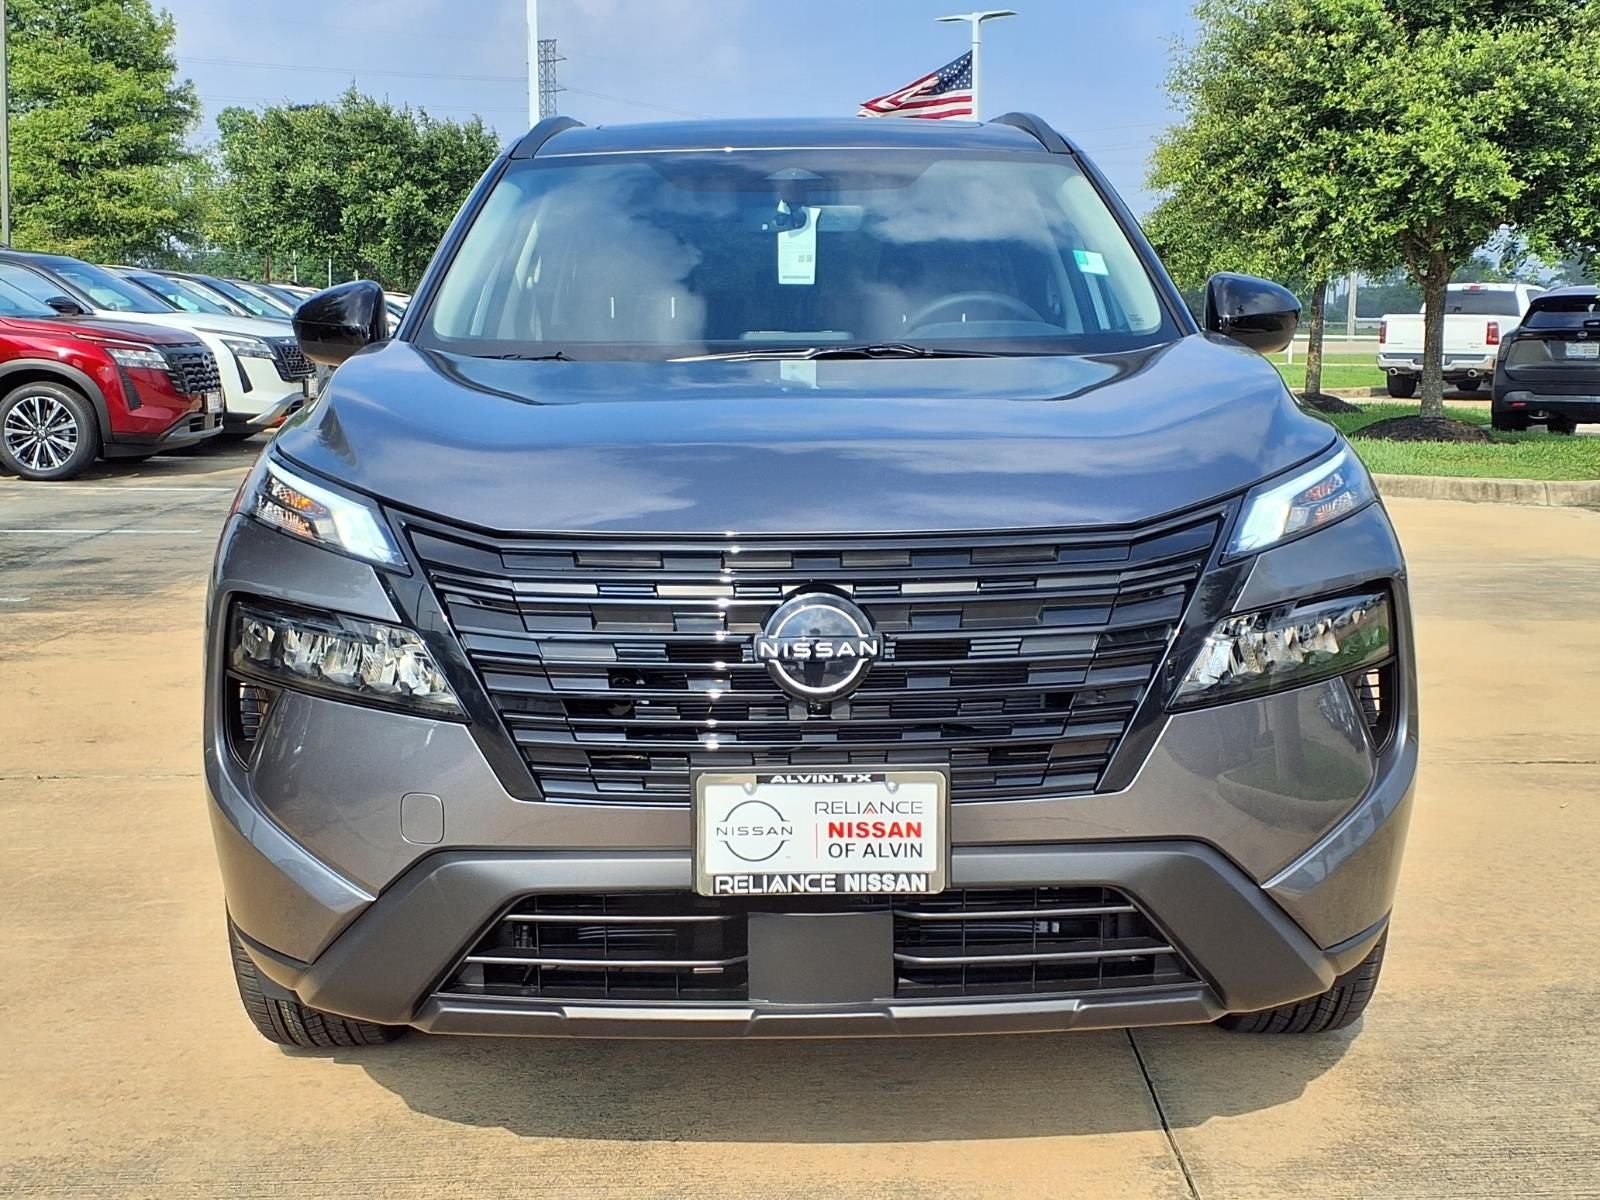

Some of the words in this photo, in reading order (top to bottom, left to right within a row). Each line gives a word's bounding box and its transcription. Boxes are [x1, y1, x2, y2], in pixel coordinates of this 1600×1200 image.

[760, 640, 878, 658] NISSAN
[843, 774, 872, 783] TX
[814, 800, 924, 815] RELIANCE
[716, 826, 793, 837] NISSAN
[828, 821, 922, 839] NISSAN
[828, 842, 857, 859] OF
[862, 842, 923, 859] ALVIN
[715, 874, 837, 894] RELIANCE
[844, 873, 927, 893] NISSAN
